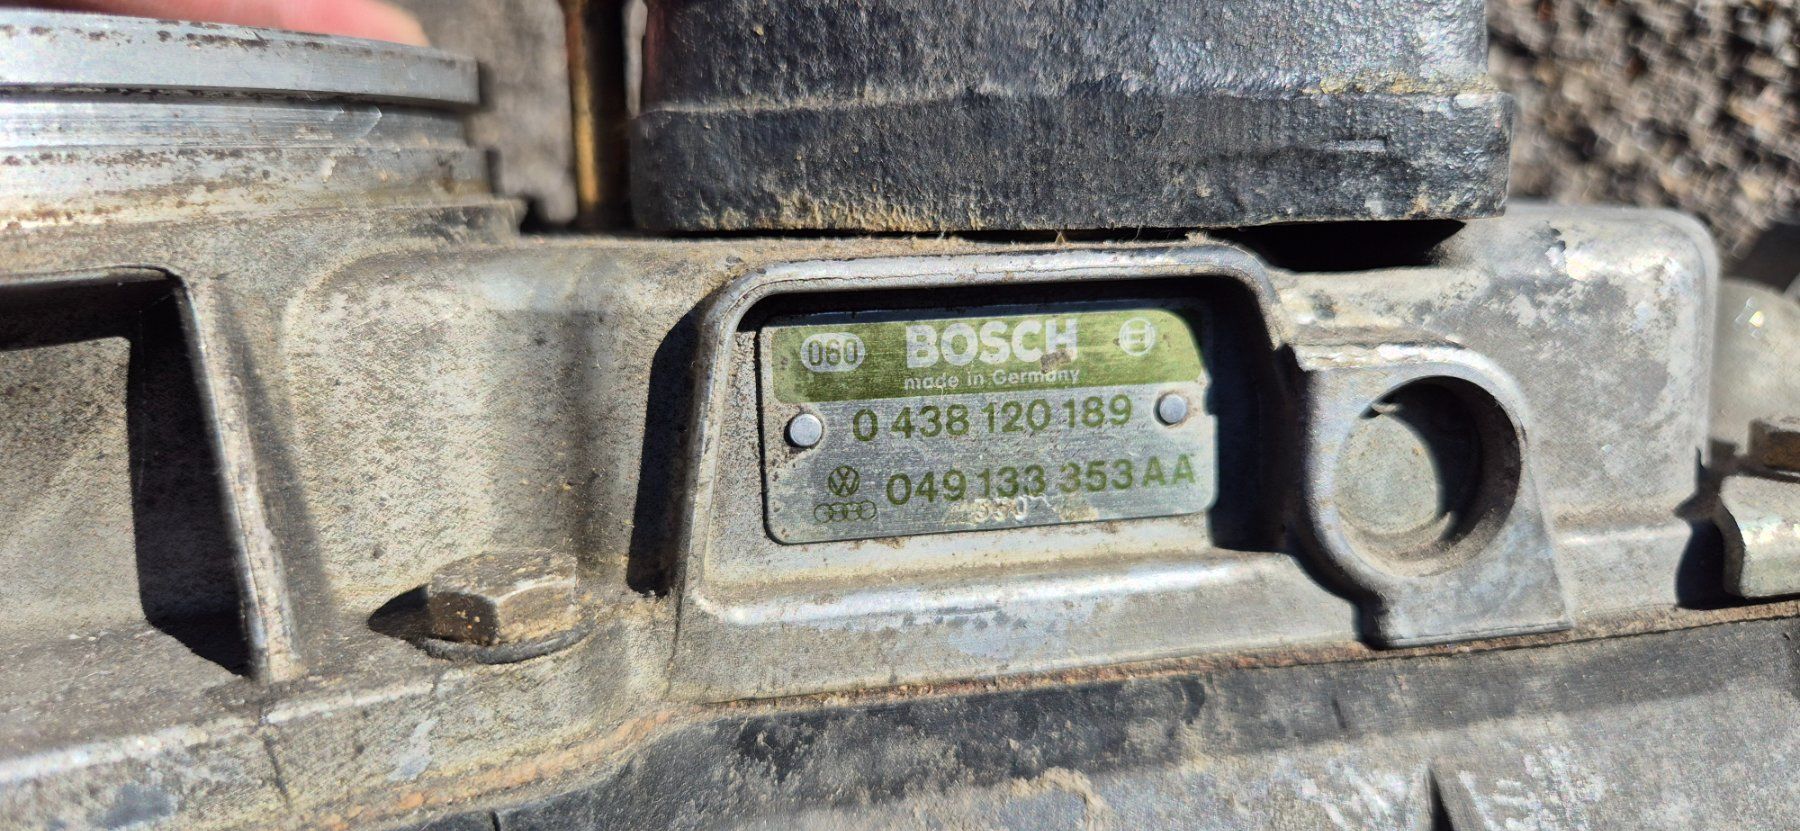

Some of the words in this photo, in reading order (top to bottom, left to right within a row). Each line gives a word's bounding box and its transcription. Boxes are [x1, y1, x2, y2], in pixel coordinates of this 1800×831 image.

[808, 338, 858, 366] 060
[905, 318, 1079, 368] BOSCH
[904, 372, 959, 391] made
[967, 372, 984, 387] in
[992, 368, 1080, 385] Germany
[852, 408, 878, 442] 0
[891, 403, 971, 440] 438
[981, 401, 1052, 434] 120
[1065, 394, 1133, 429] 189
[886, 468, 967, 506] 049
[977, 464, 1046, 500] 133
